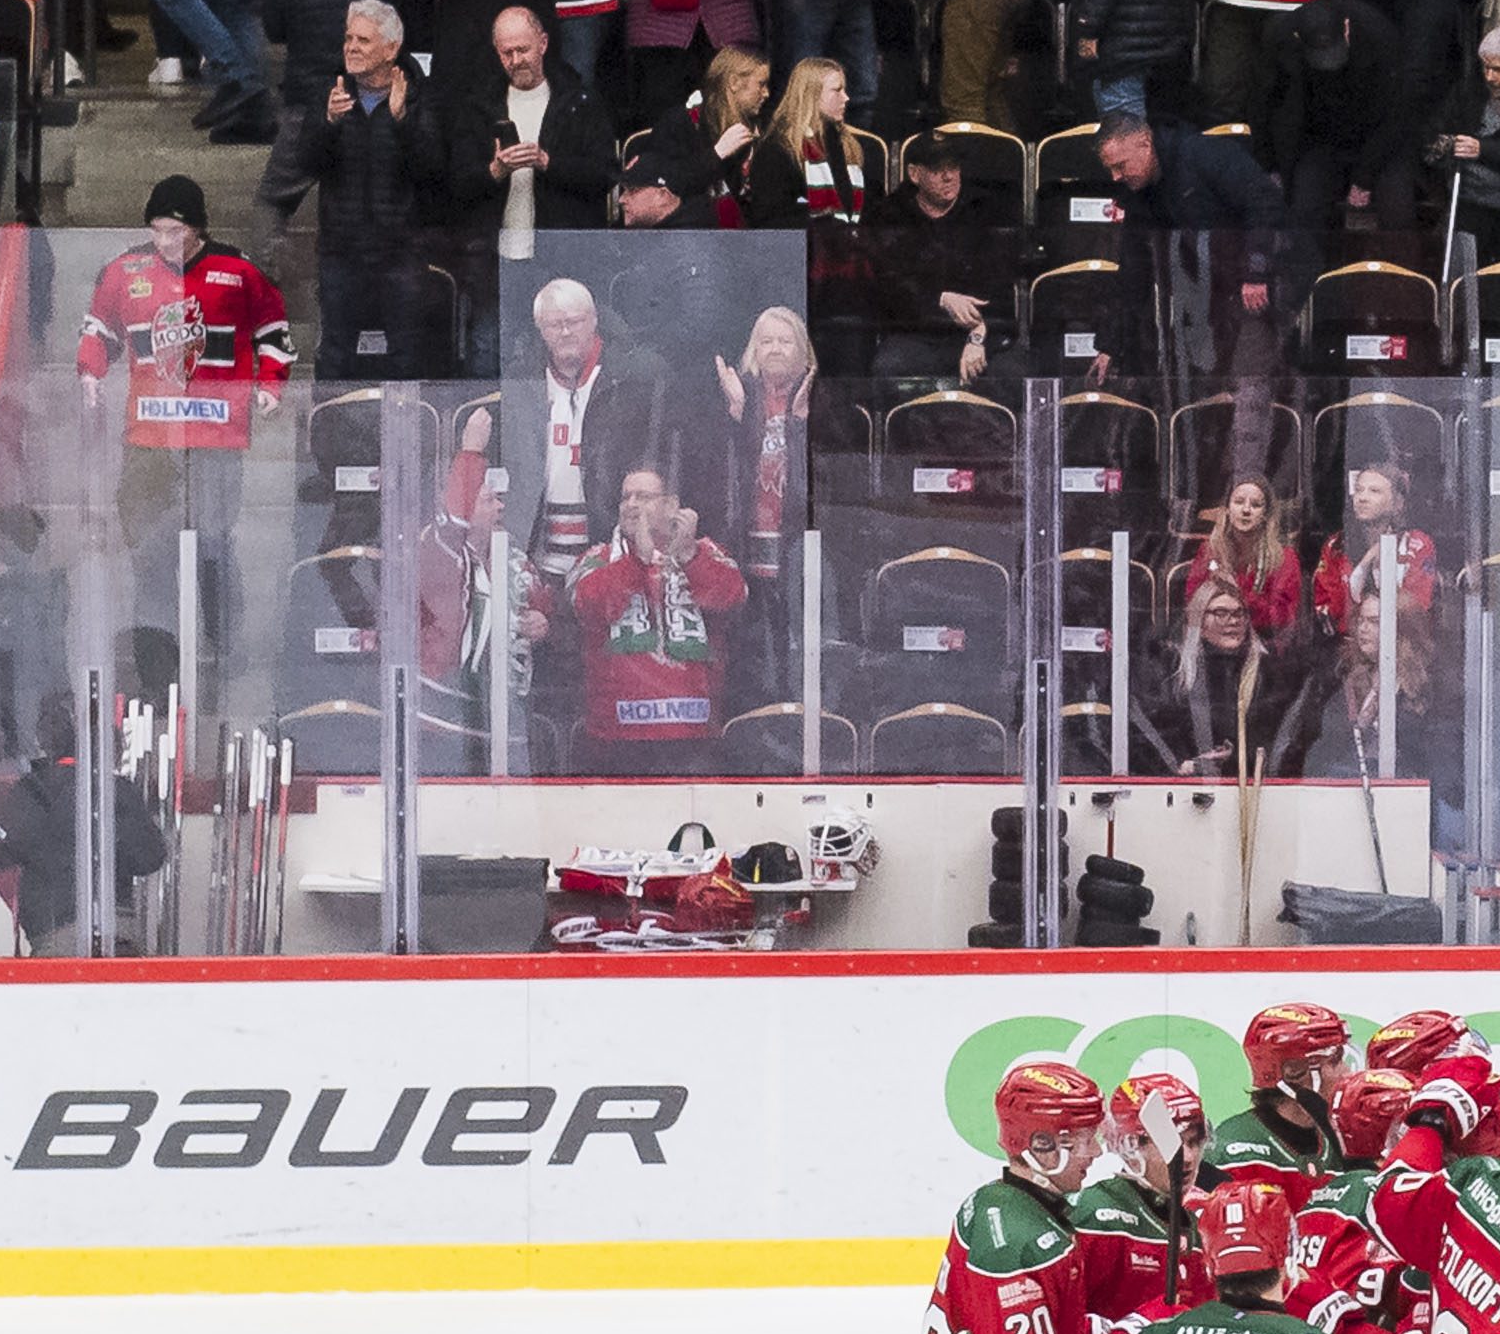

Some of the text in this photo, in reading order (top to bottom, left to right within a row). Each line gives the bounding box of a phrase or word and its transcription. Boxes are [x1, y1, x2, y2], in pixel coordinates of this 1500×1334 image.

[153, 324, 204, 347] MODO
[141, 399, 227, 421] HOLMEN
[618, 699, 711, 724] HOLMEN
[13, 1085, 690, 1170] BAUER
